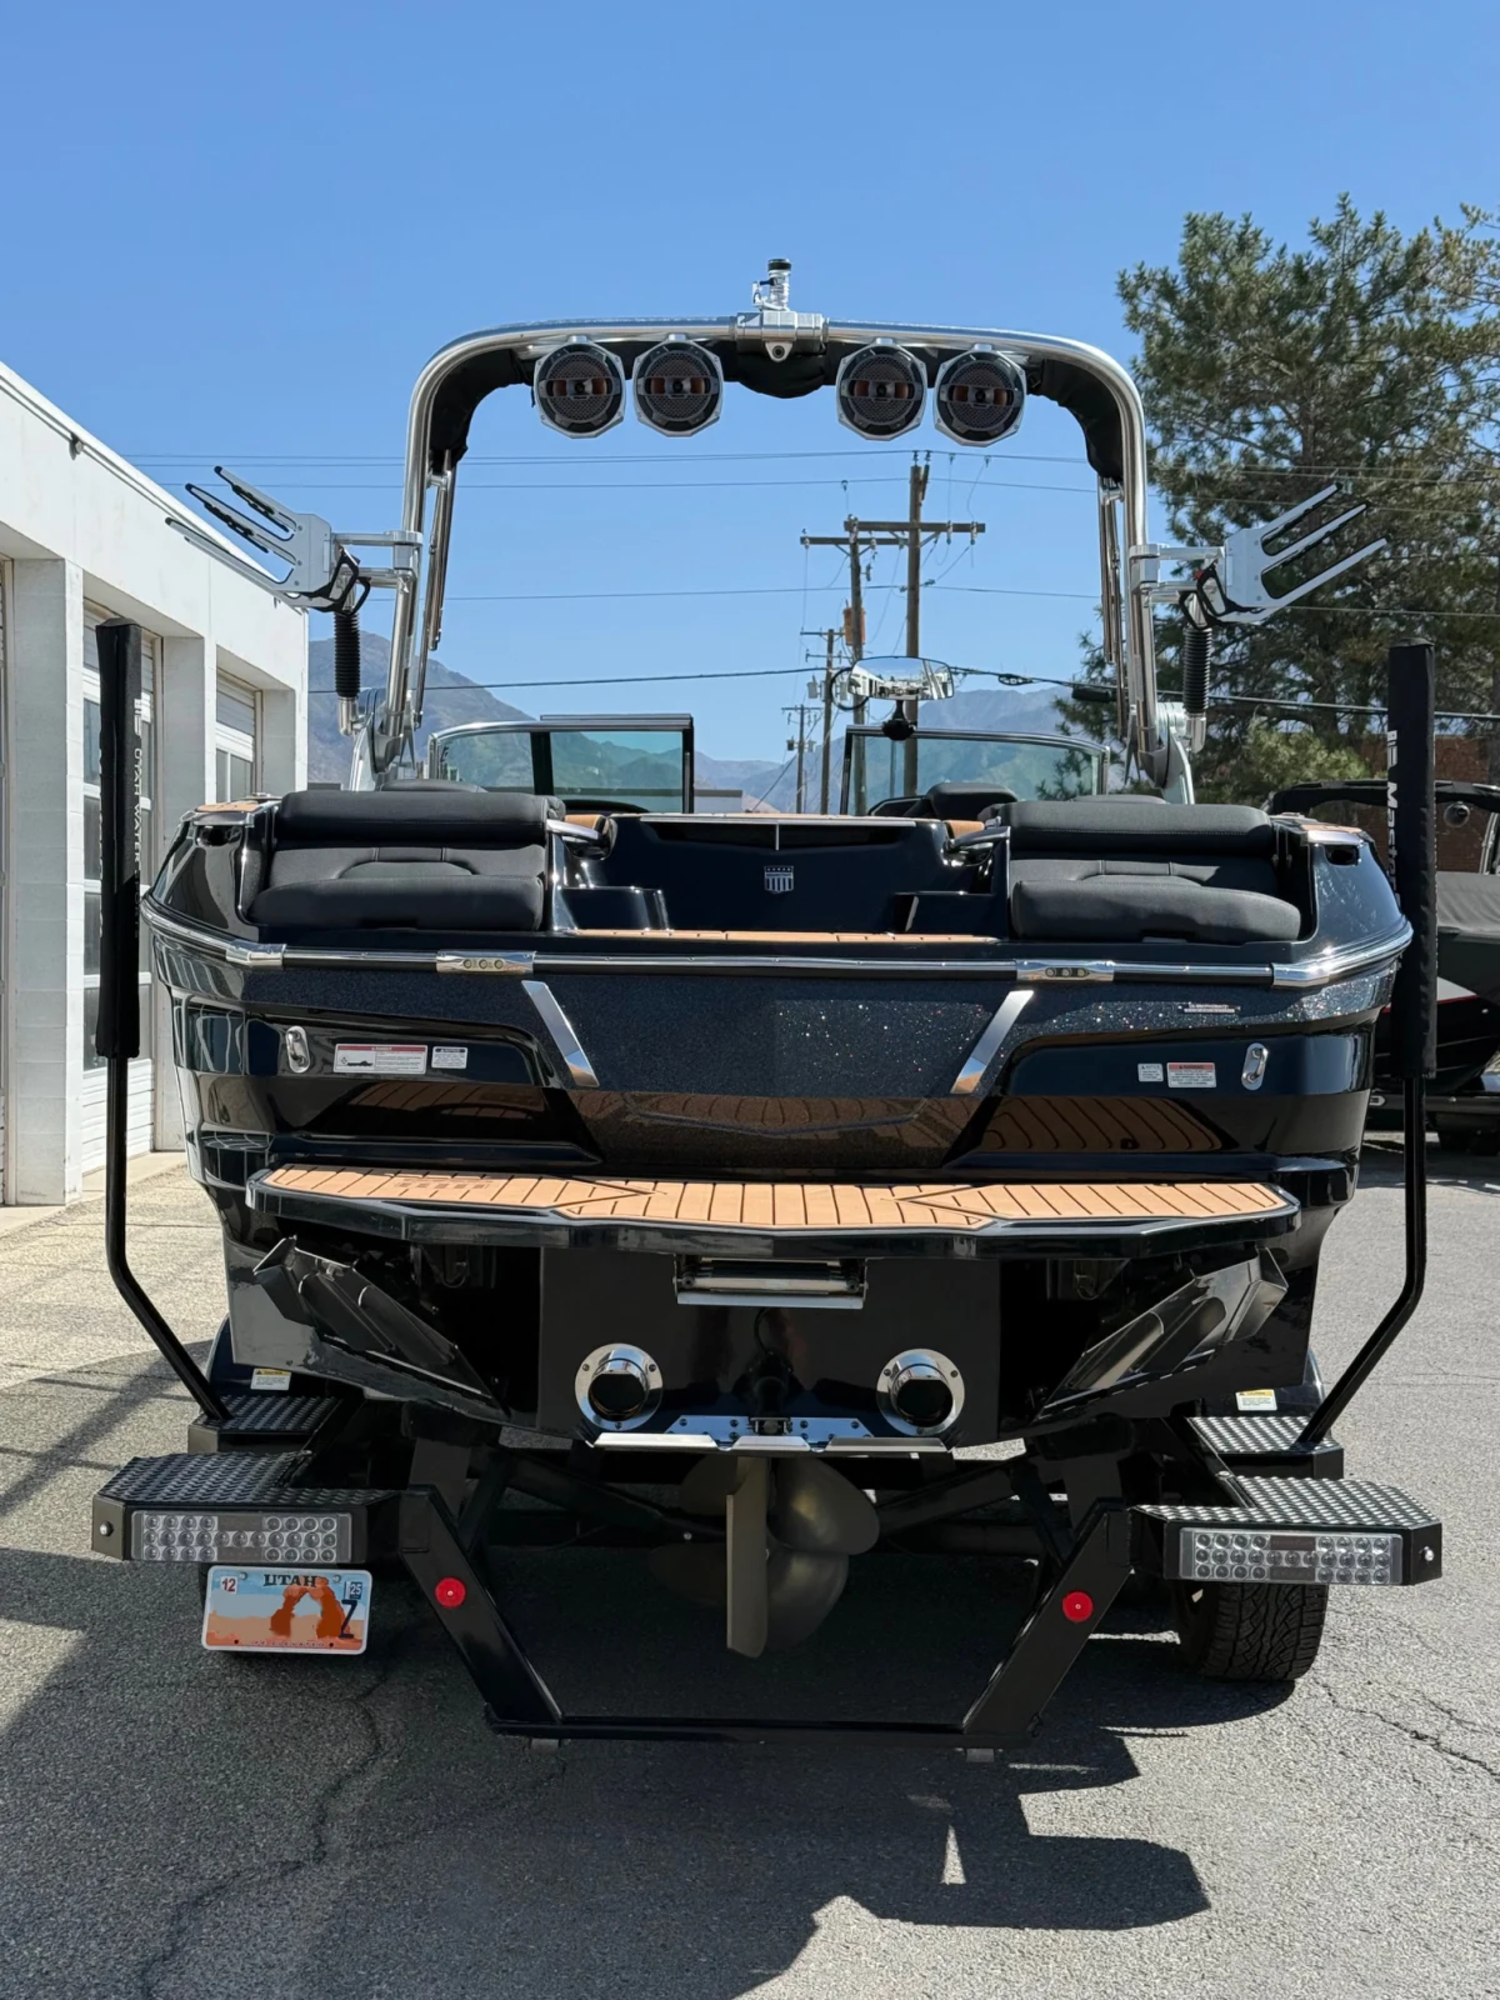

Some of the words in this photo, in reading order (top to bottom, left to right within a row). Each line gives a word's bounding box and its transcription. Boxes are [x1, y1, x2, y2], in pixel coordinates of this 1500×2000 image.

[134, 747, 142, 796] UTAH
[222, 1578, 236, 1592] 12
[263, 1574, 317, 1587] UTAH
[350, 1583, 362, 1595] 25
